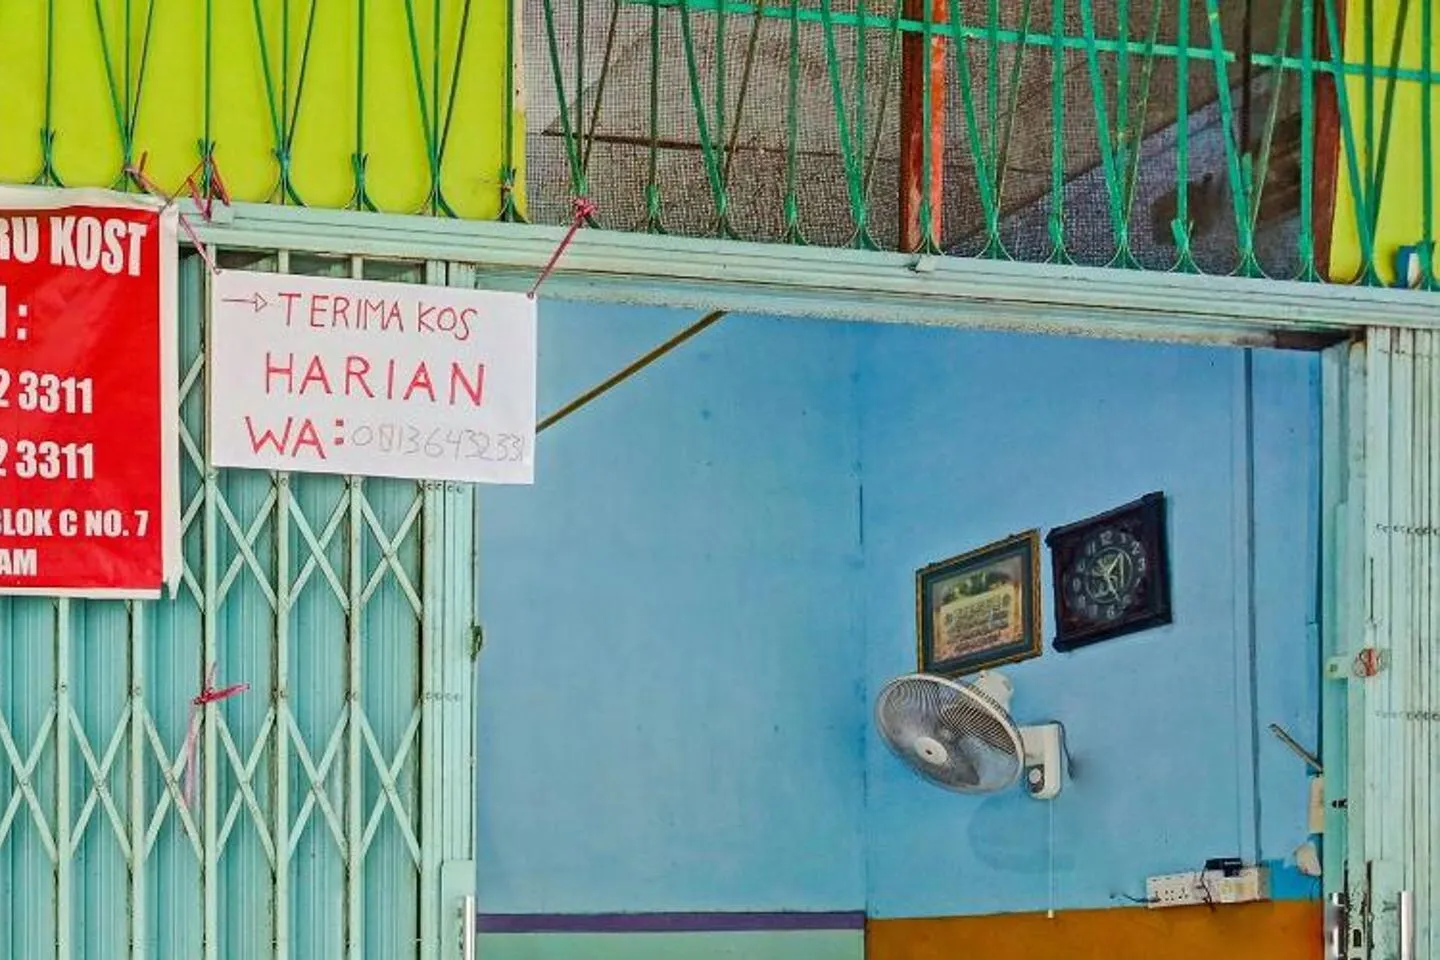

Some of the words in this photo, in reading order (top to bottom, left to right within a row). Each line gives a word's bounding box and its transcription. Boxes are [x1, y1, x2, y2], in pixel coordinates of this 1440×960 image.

[50, 216, 148, 276] KOST
[278, 292, 405, 332] TERIMA
[418, 301, 479, 341] KOS
[18, 370, 93, 414] 3311
[265, 352, 485, 407] HARIAN
[15, 439, 94, 479] 3311
[59, 508, 78, 537] C
[84, 509, 129, 538] NO.
[134, 510, 149, 537] 7
